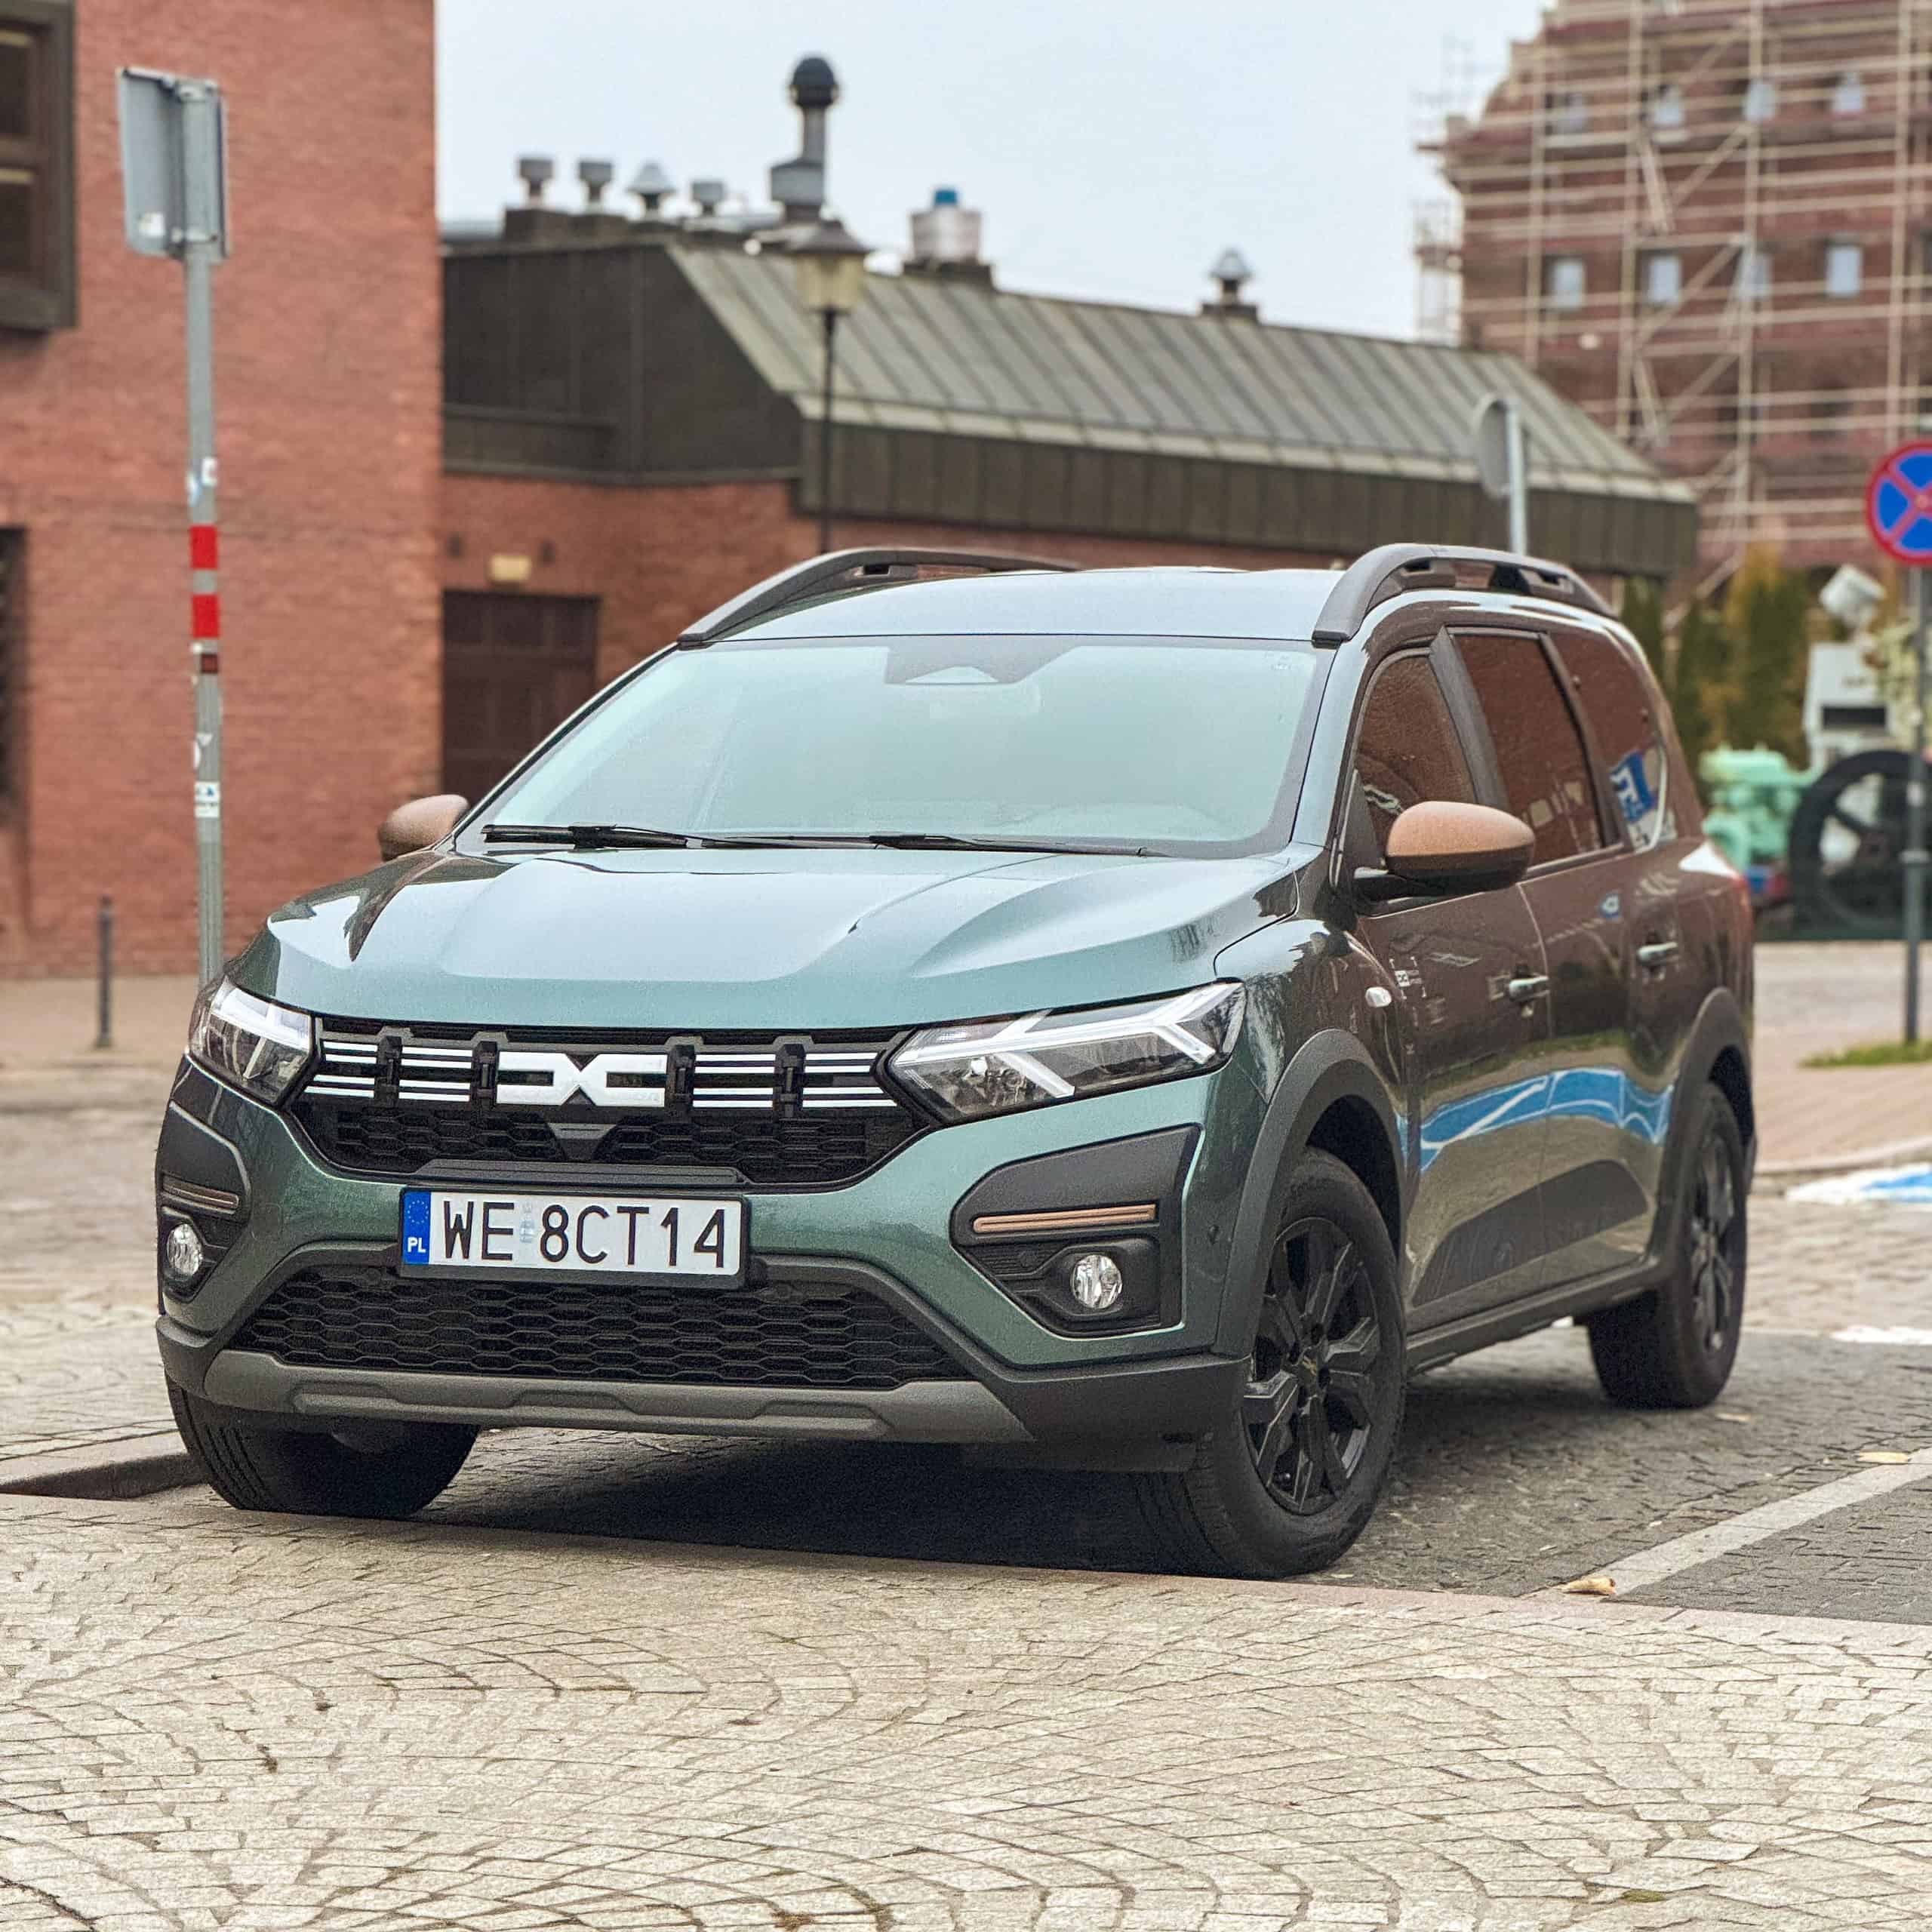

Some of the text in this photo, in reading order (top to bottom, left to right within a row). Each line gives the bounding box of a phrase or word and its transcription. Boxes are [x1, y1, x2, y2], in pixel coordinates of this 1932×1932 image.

[408, 1237, 426, 1253] PL
[443, 1201, 726, 1269] WE 8CT14
